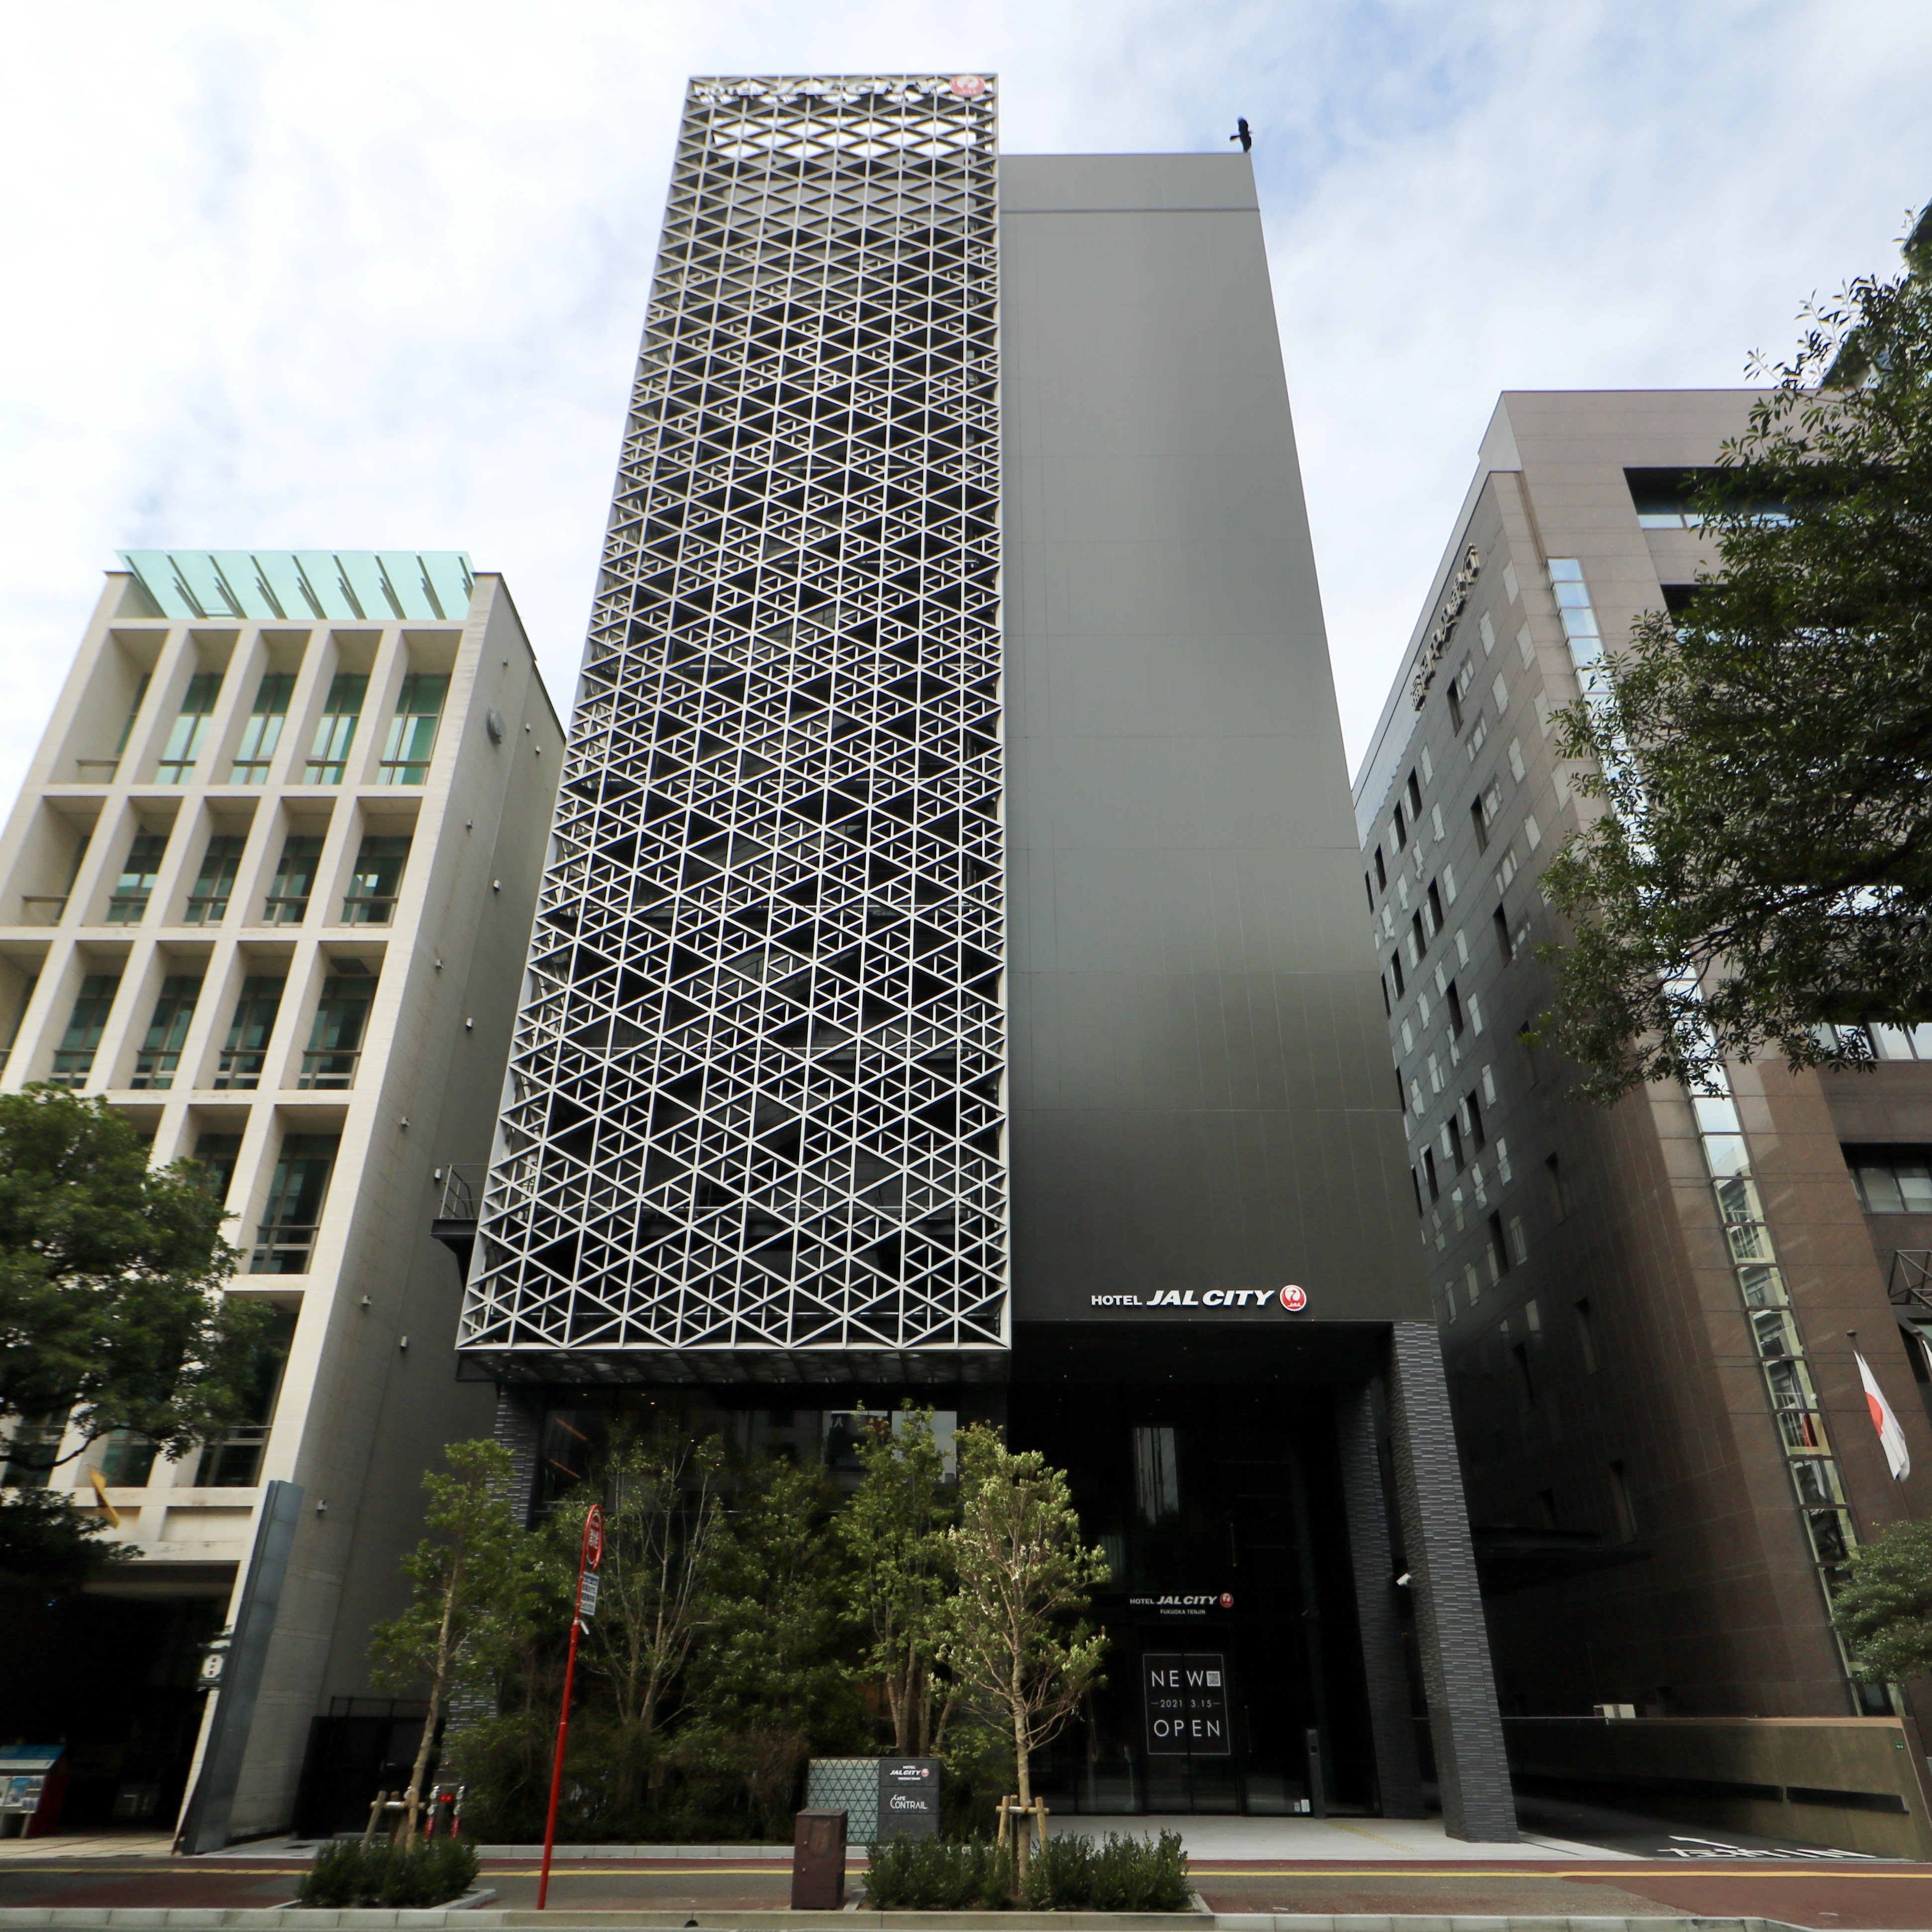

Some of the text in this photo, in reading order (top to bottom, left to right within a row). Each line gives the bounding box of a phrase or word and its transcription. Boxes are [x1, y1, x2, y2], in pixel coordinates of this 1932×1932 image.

[1092, 1290, 1275, 1306] HOTEL JAL CITY
[1156, 1596, 1181, 1605] JAL
[1183, 1596, 1218, 1605] CITY
[1151, 1670, 1204, 1687] NEW
[1153, 1720, 1220, 1737] OPEN
